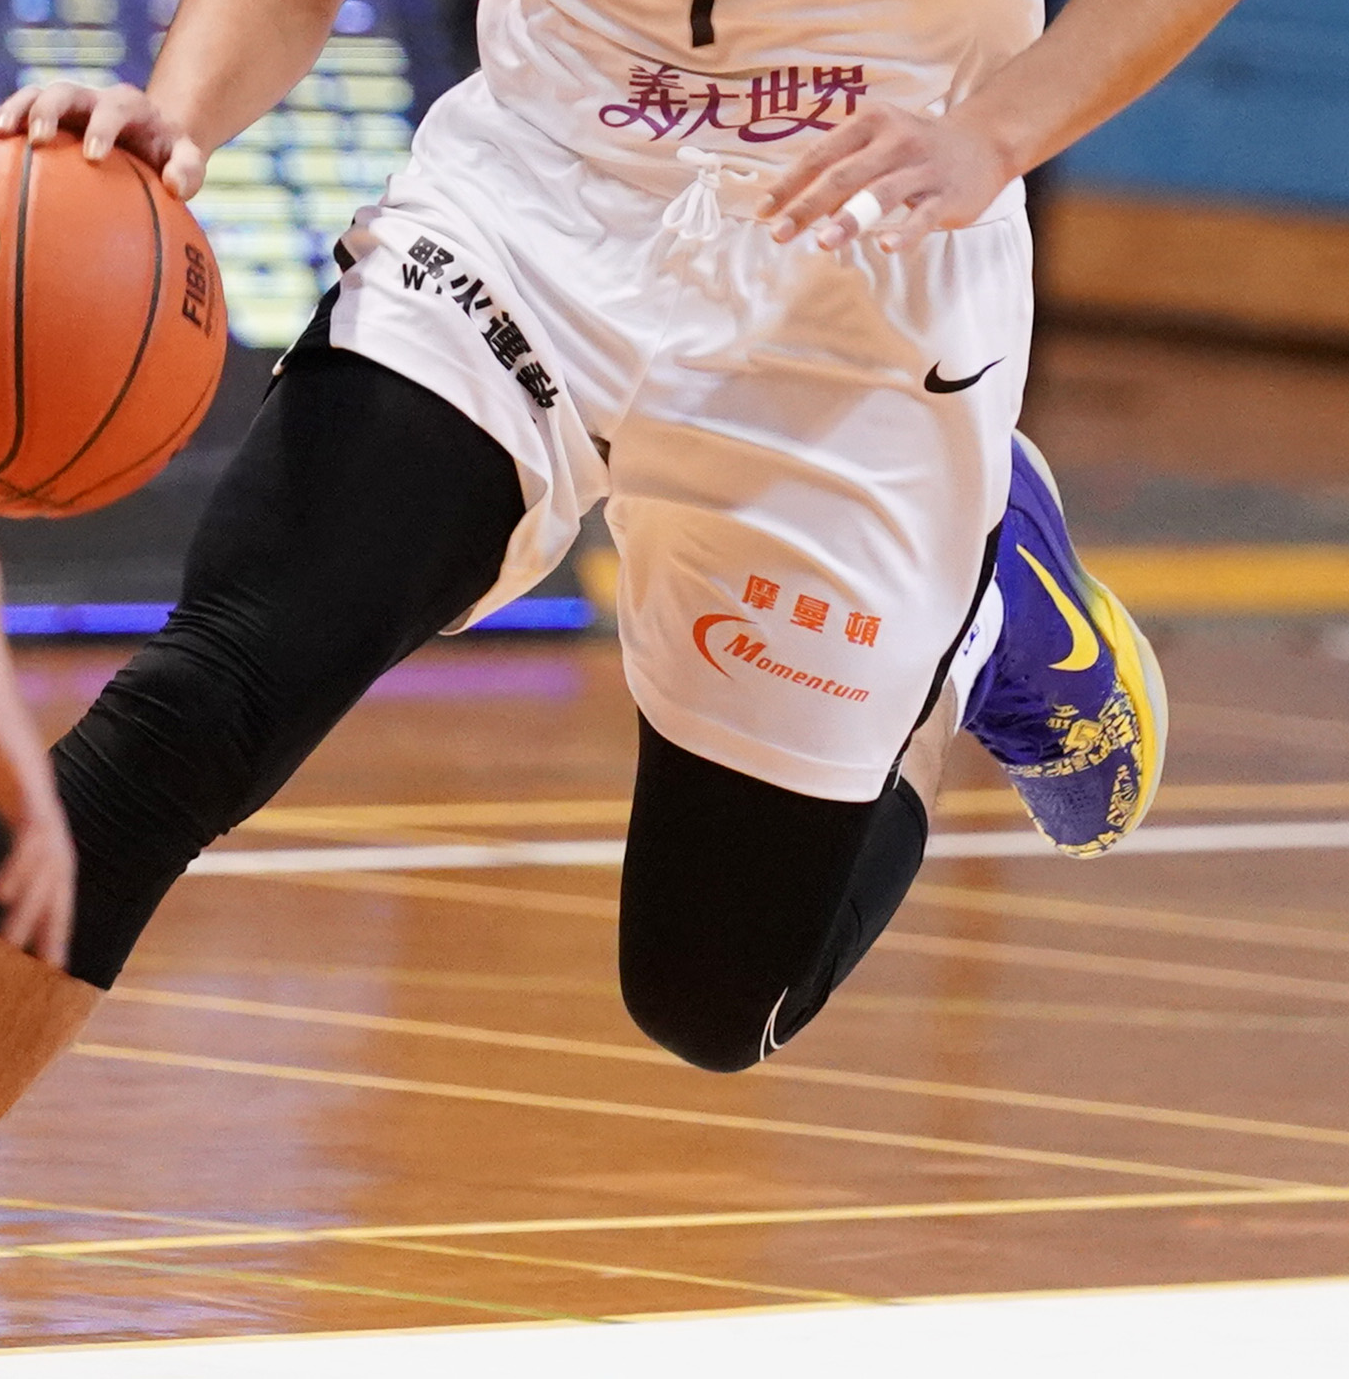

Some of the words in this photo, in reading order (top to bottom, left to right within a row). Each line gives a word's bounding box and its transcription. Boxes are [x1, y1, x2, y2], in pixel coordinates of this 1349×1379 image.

[599, 64, 869, 143] 義大世界
[182, 242, 205, 328] FIBA
[742, 574, 882, 647] 摩曼頓
[723, 633, 870, 703] Momentum
